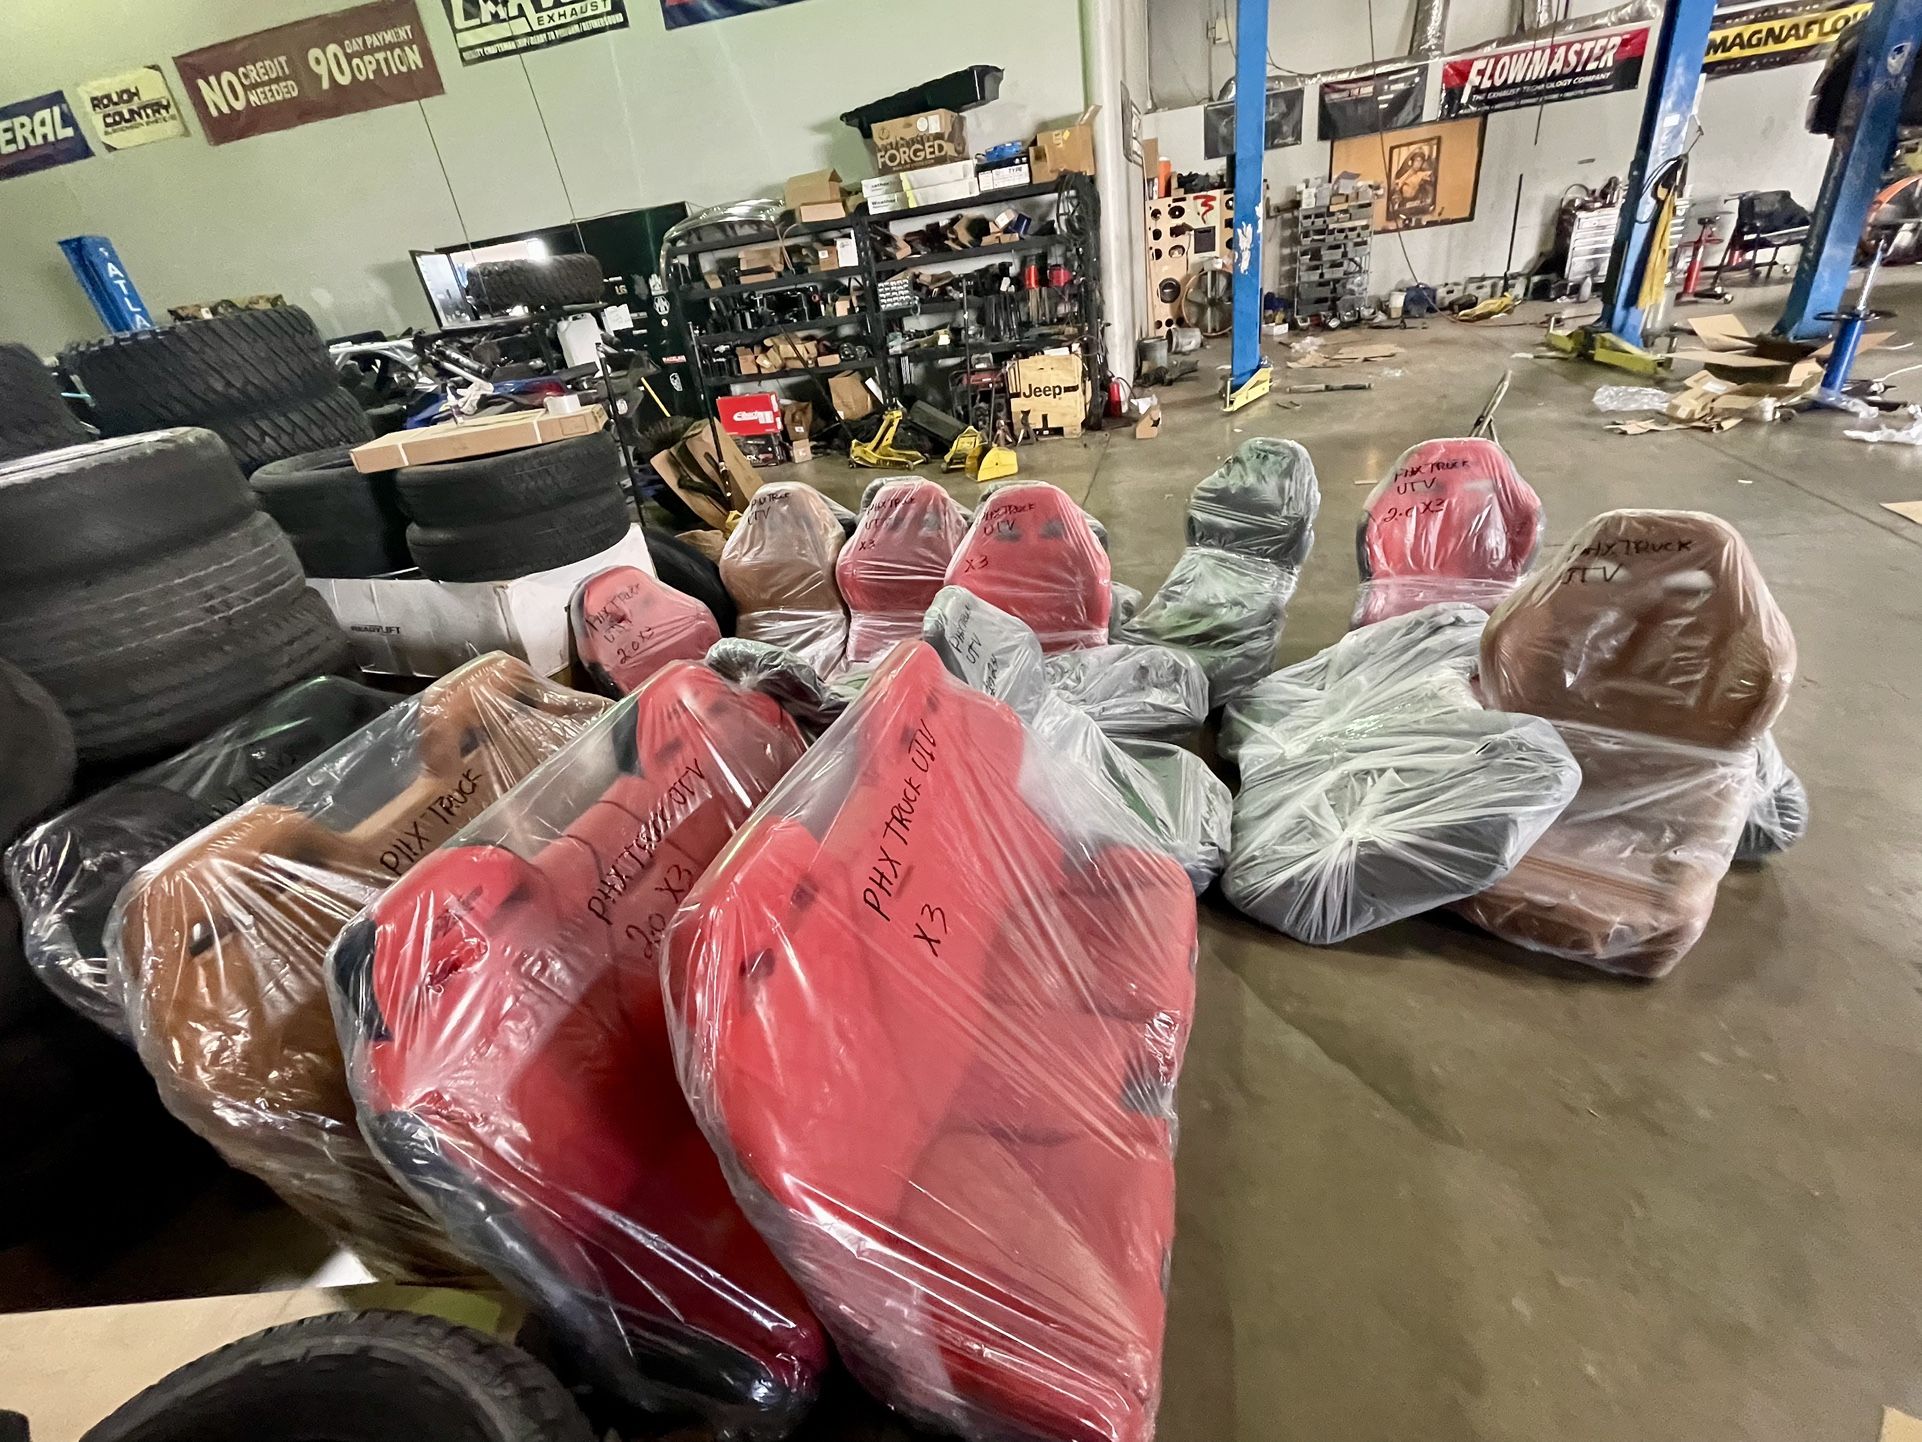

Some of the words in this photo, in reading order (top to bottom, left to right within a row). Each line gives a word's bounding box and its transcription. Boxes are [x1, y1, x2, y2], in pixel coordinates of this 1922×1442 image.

[537, 0, 607, 26] EXHAUST
[345, 40, 364, 53] DAY
[364, 25, 413, 49] PAYMENT
[238, 56, 288, 86] CREDIT
[308, 43, 352, 90] 90
[352, 45, 424, 82] OPTION
[1460, 34, 1622, 104] FLOWMASTER
[1572, 71, 1612, 86] COMPANY
[195, 71, 247, 118] NO
[247, 80, 299, 107] NEEDED
[102, 99, 171, 128] COUNTRY
[877, 139, 948, 170] FORGED
[1022, 383, 1062, 399] Jeep
[1397, 477, 1436, 495] UTV
[983, 519, 1016, 536] UTV
[1617, 539, 1693, 555] TRUCK
[964, 555, 989, 573] X3
[432, 768, 483, 824] TRUCK
[862, 846, 902, 922] PHX
[882, 777, 922, 846] TRUCK
[587, 864, 632, 926] PHX
[655, 864, 694, 904] X3
[913, 903, 948, 957] X3
